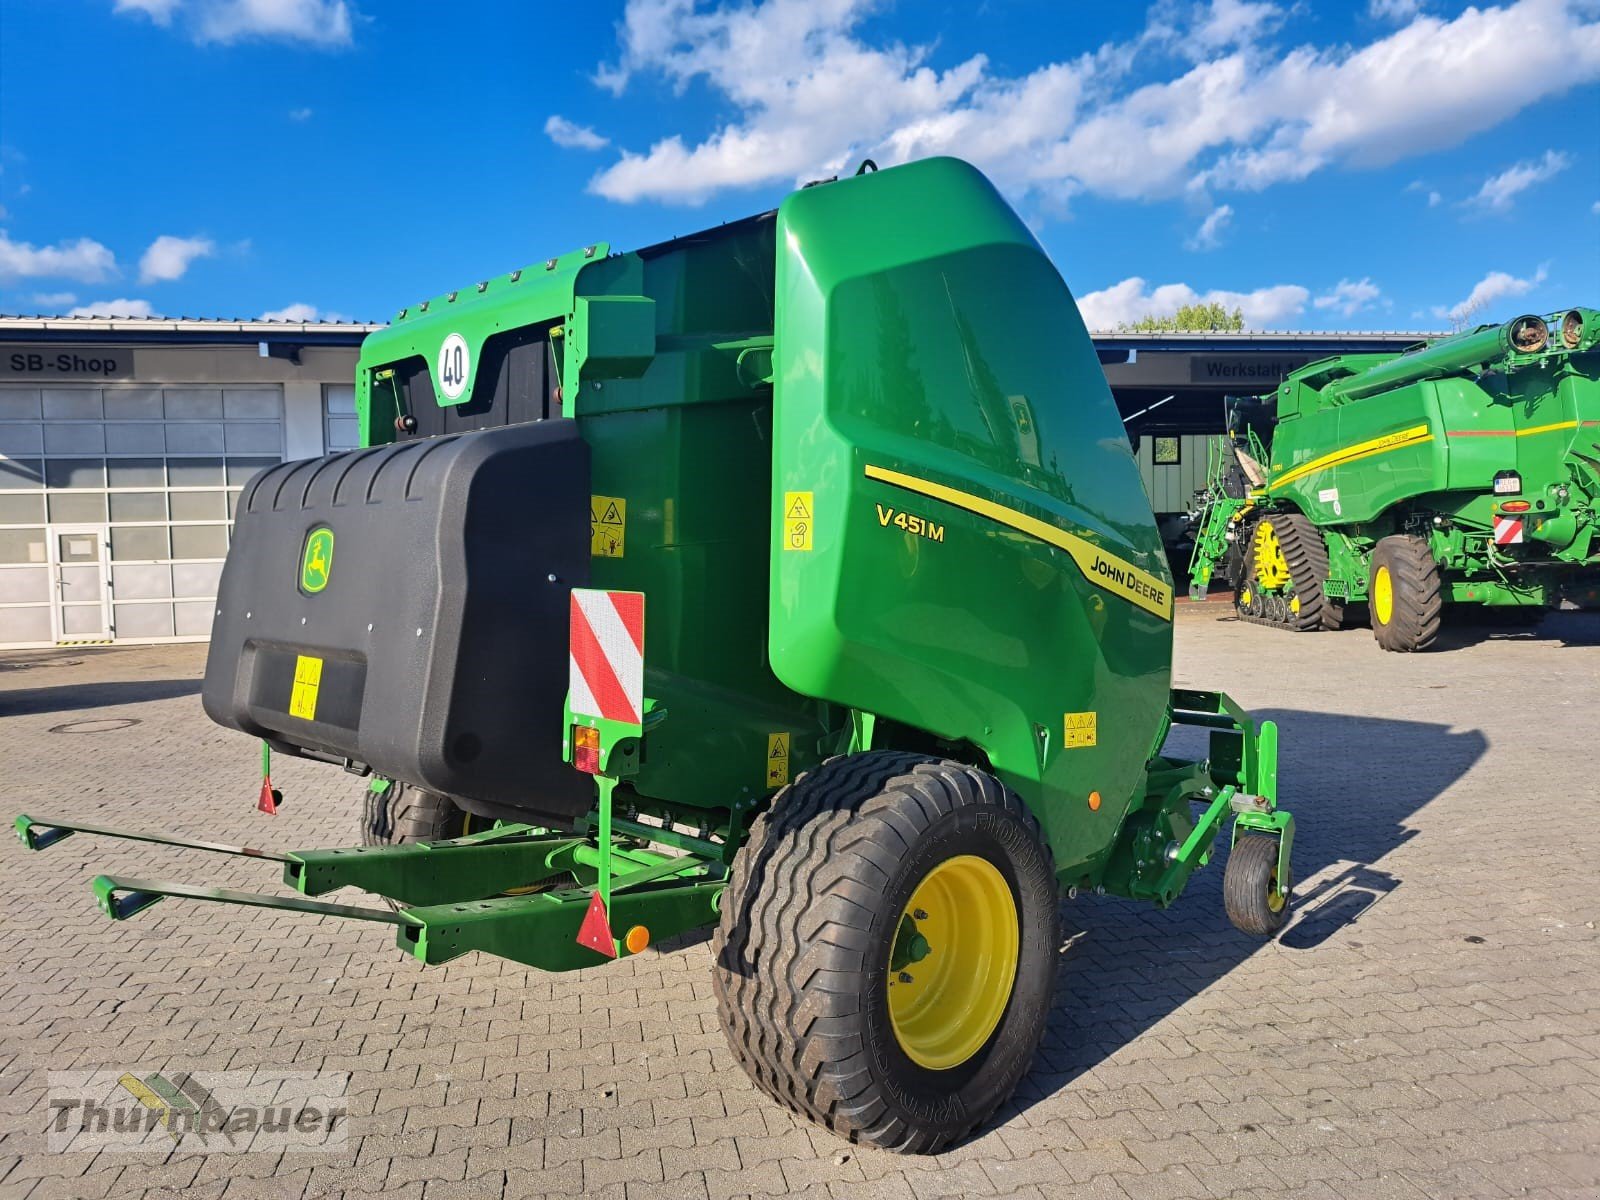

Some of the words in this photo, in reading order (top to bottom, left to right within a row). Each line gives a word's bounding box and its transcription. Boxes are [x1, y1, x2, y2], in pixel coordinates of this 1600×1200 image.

[10, 353, 117, 376] SB-Shop
[443, 345, 462, 387] 40
[1207, 362, 1281, 377] Werkstatt
[1091, 555, 1125, 585] JOHN
[1126, 572, 1165, 606] DEERE
